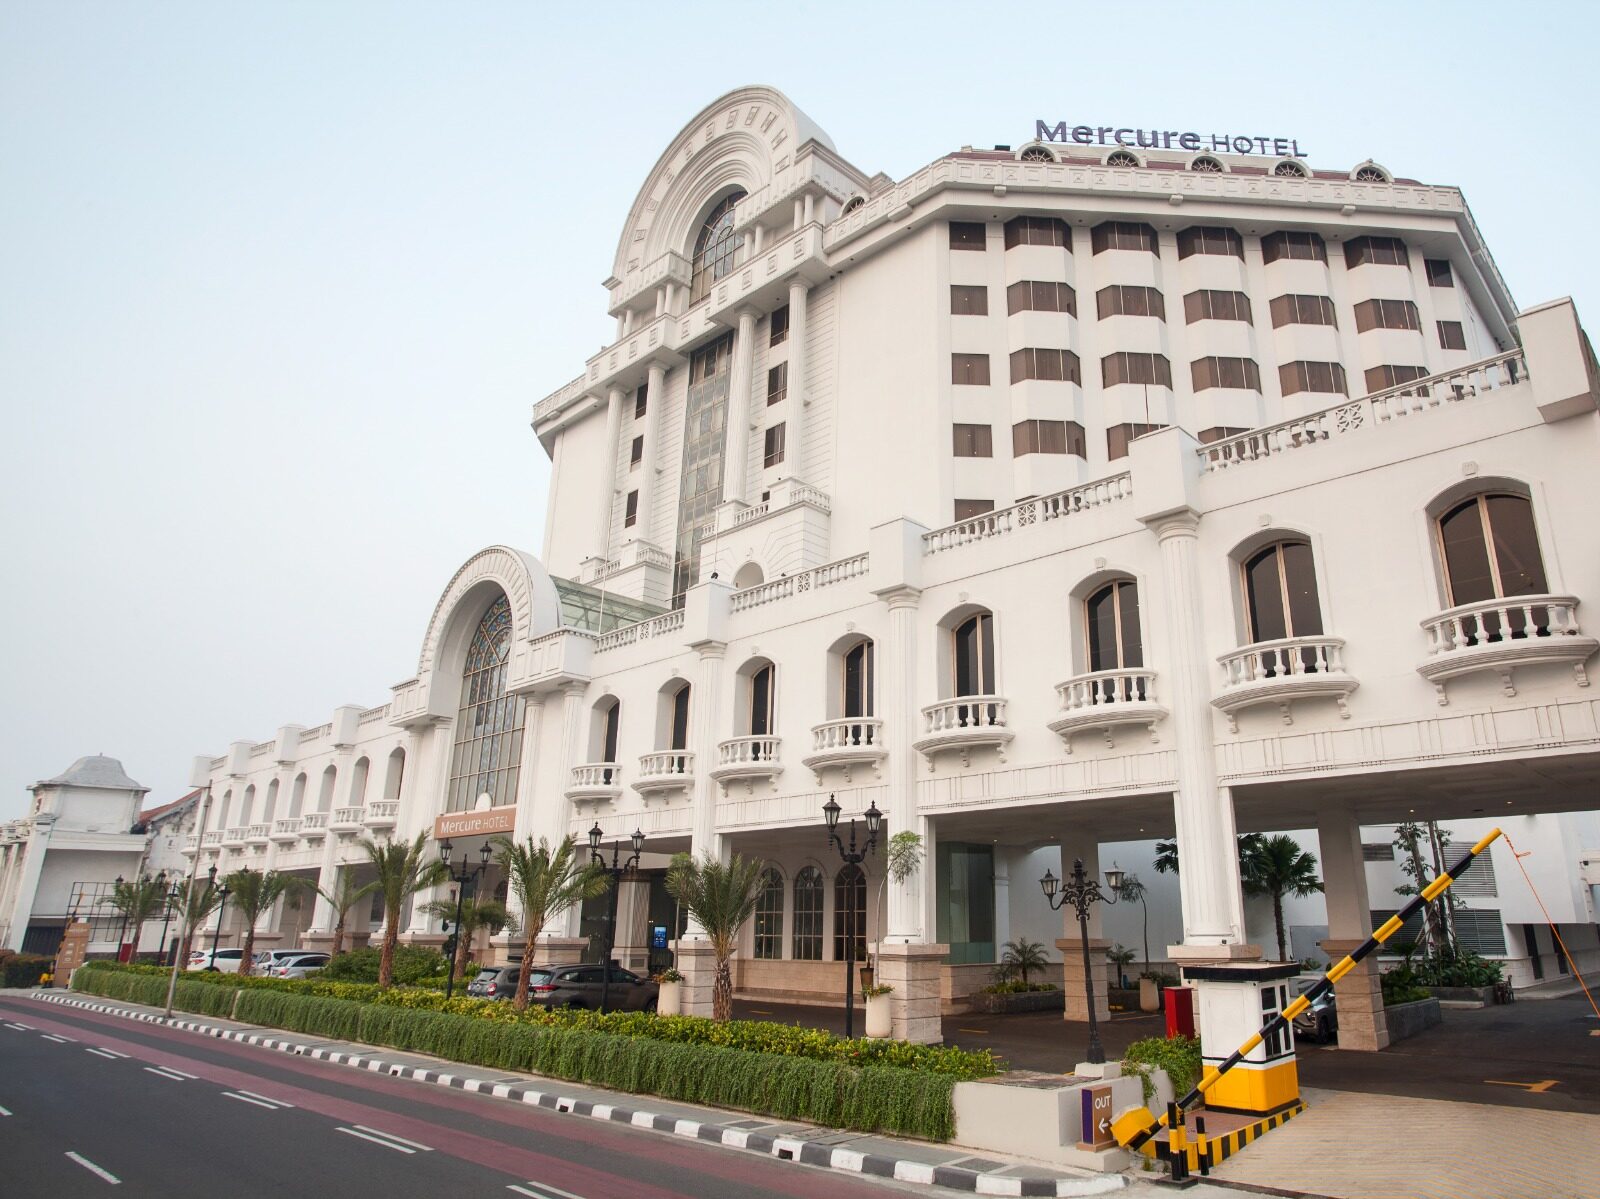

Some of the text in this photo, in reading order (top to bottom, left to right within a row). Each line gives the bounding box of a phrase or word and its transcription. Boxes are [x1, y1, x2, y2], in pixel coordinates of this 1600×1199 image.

[1036, 119, 1308, 158] Mercure HOTEL
[441, 815, 509, 834] Mercure HOTEL
[1094, 1095, 1111, 1110] OUT
